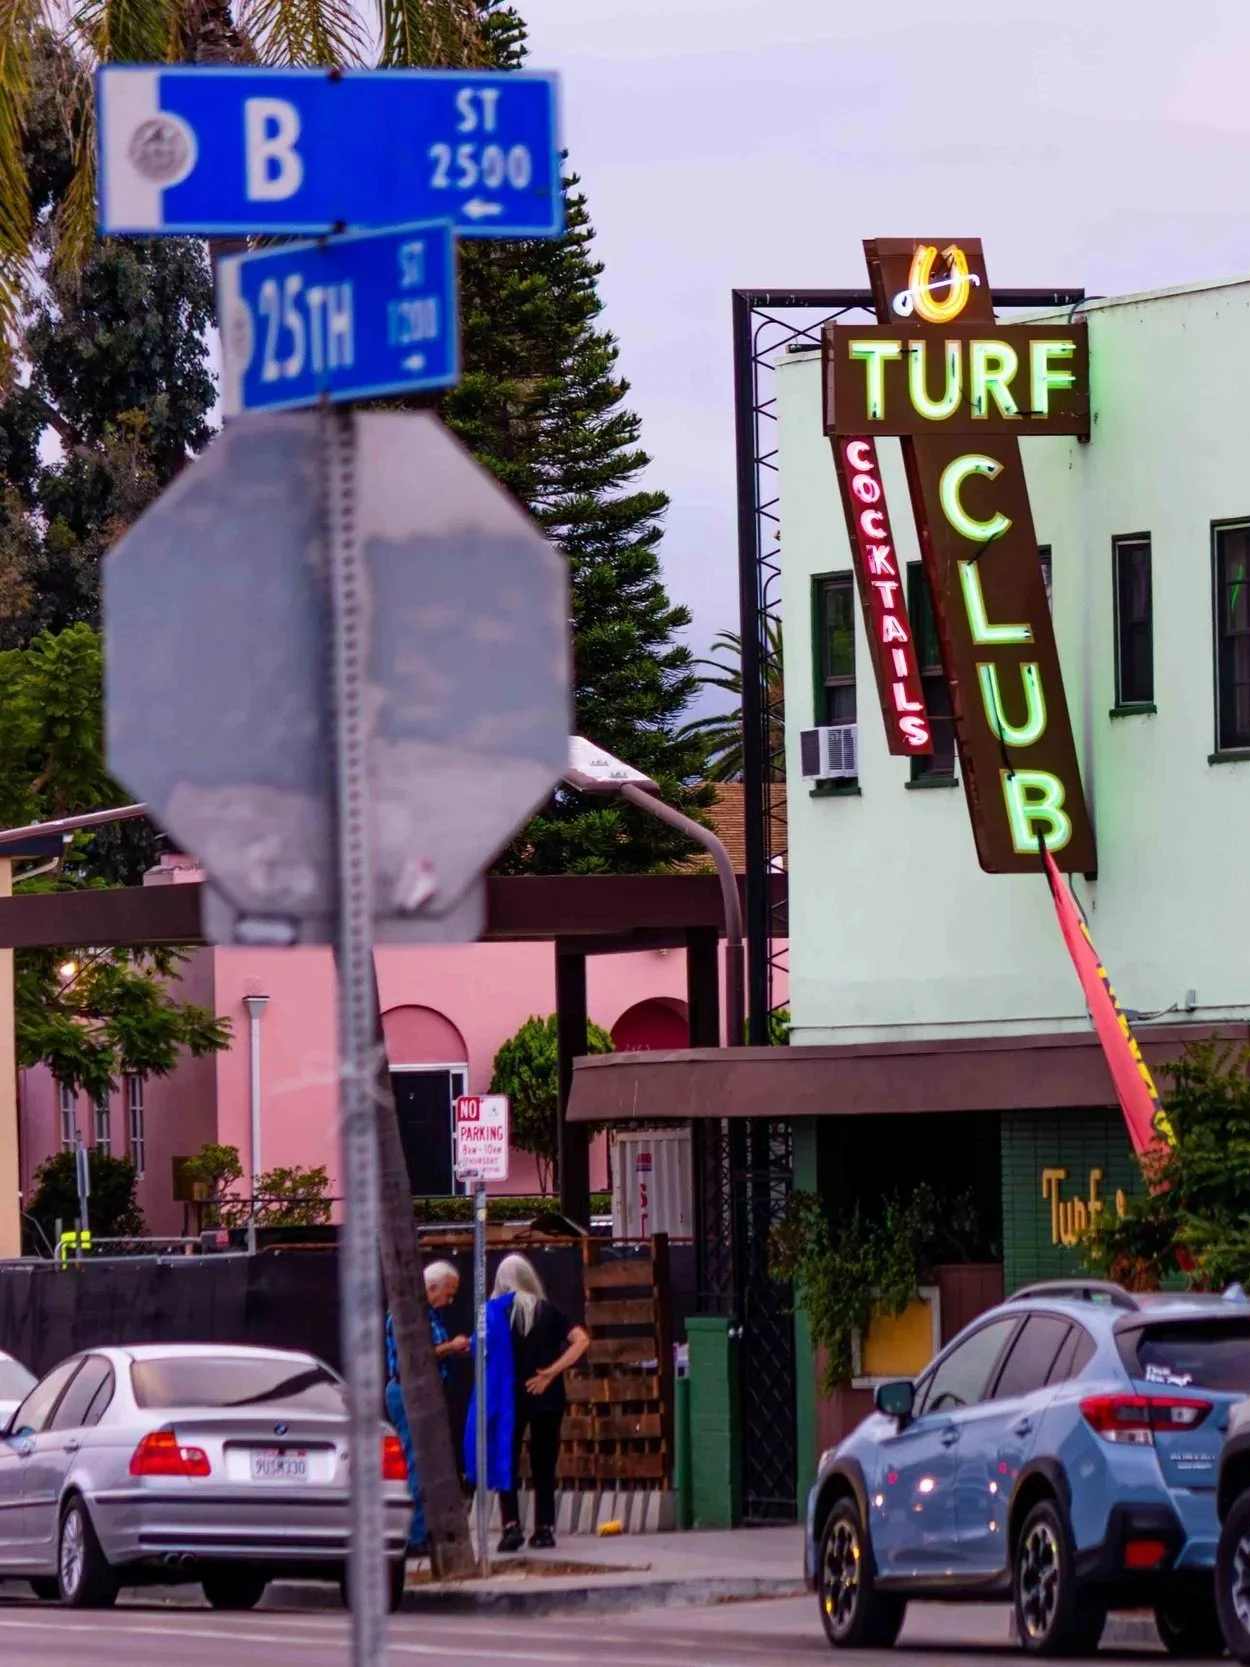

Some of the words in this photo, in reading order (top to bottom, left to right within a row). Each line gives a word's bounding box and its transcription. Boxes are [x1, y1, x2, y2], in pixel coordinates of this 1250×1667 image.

[244, 97, 304, 201] B
[454, 88, 501, 134] ST
[428, 143, 532, 190] 2500
[258, 272, 356, 383] 25TH
[848, 339, 1077, 420] TURF
[845, 439, 930, 748] COCKTAILS
[938, 453, 1073, 854] CLUB
[459, 1099, 478, 1119] NO
[459, 1125, 504, 1142] PARKING
